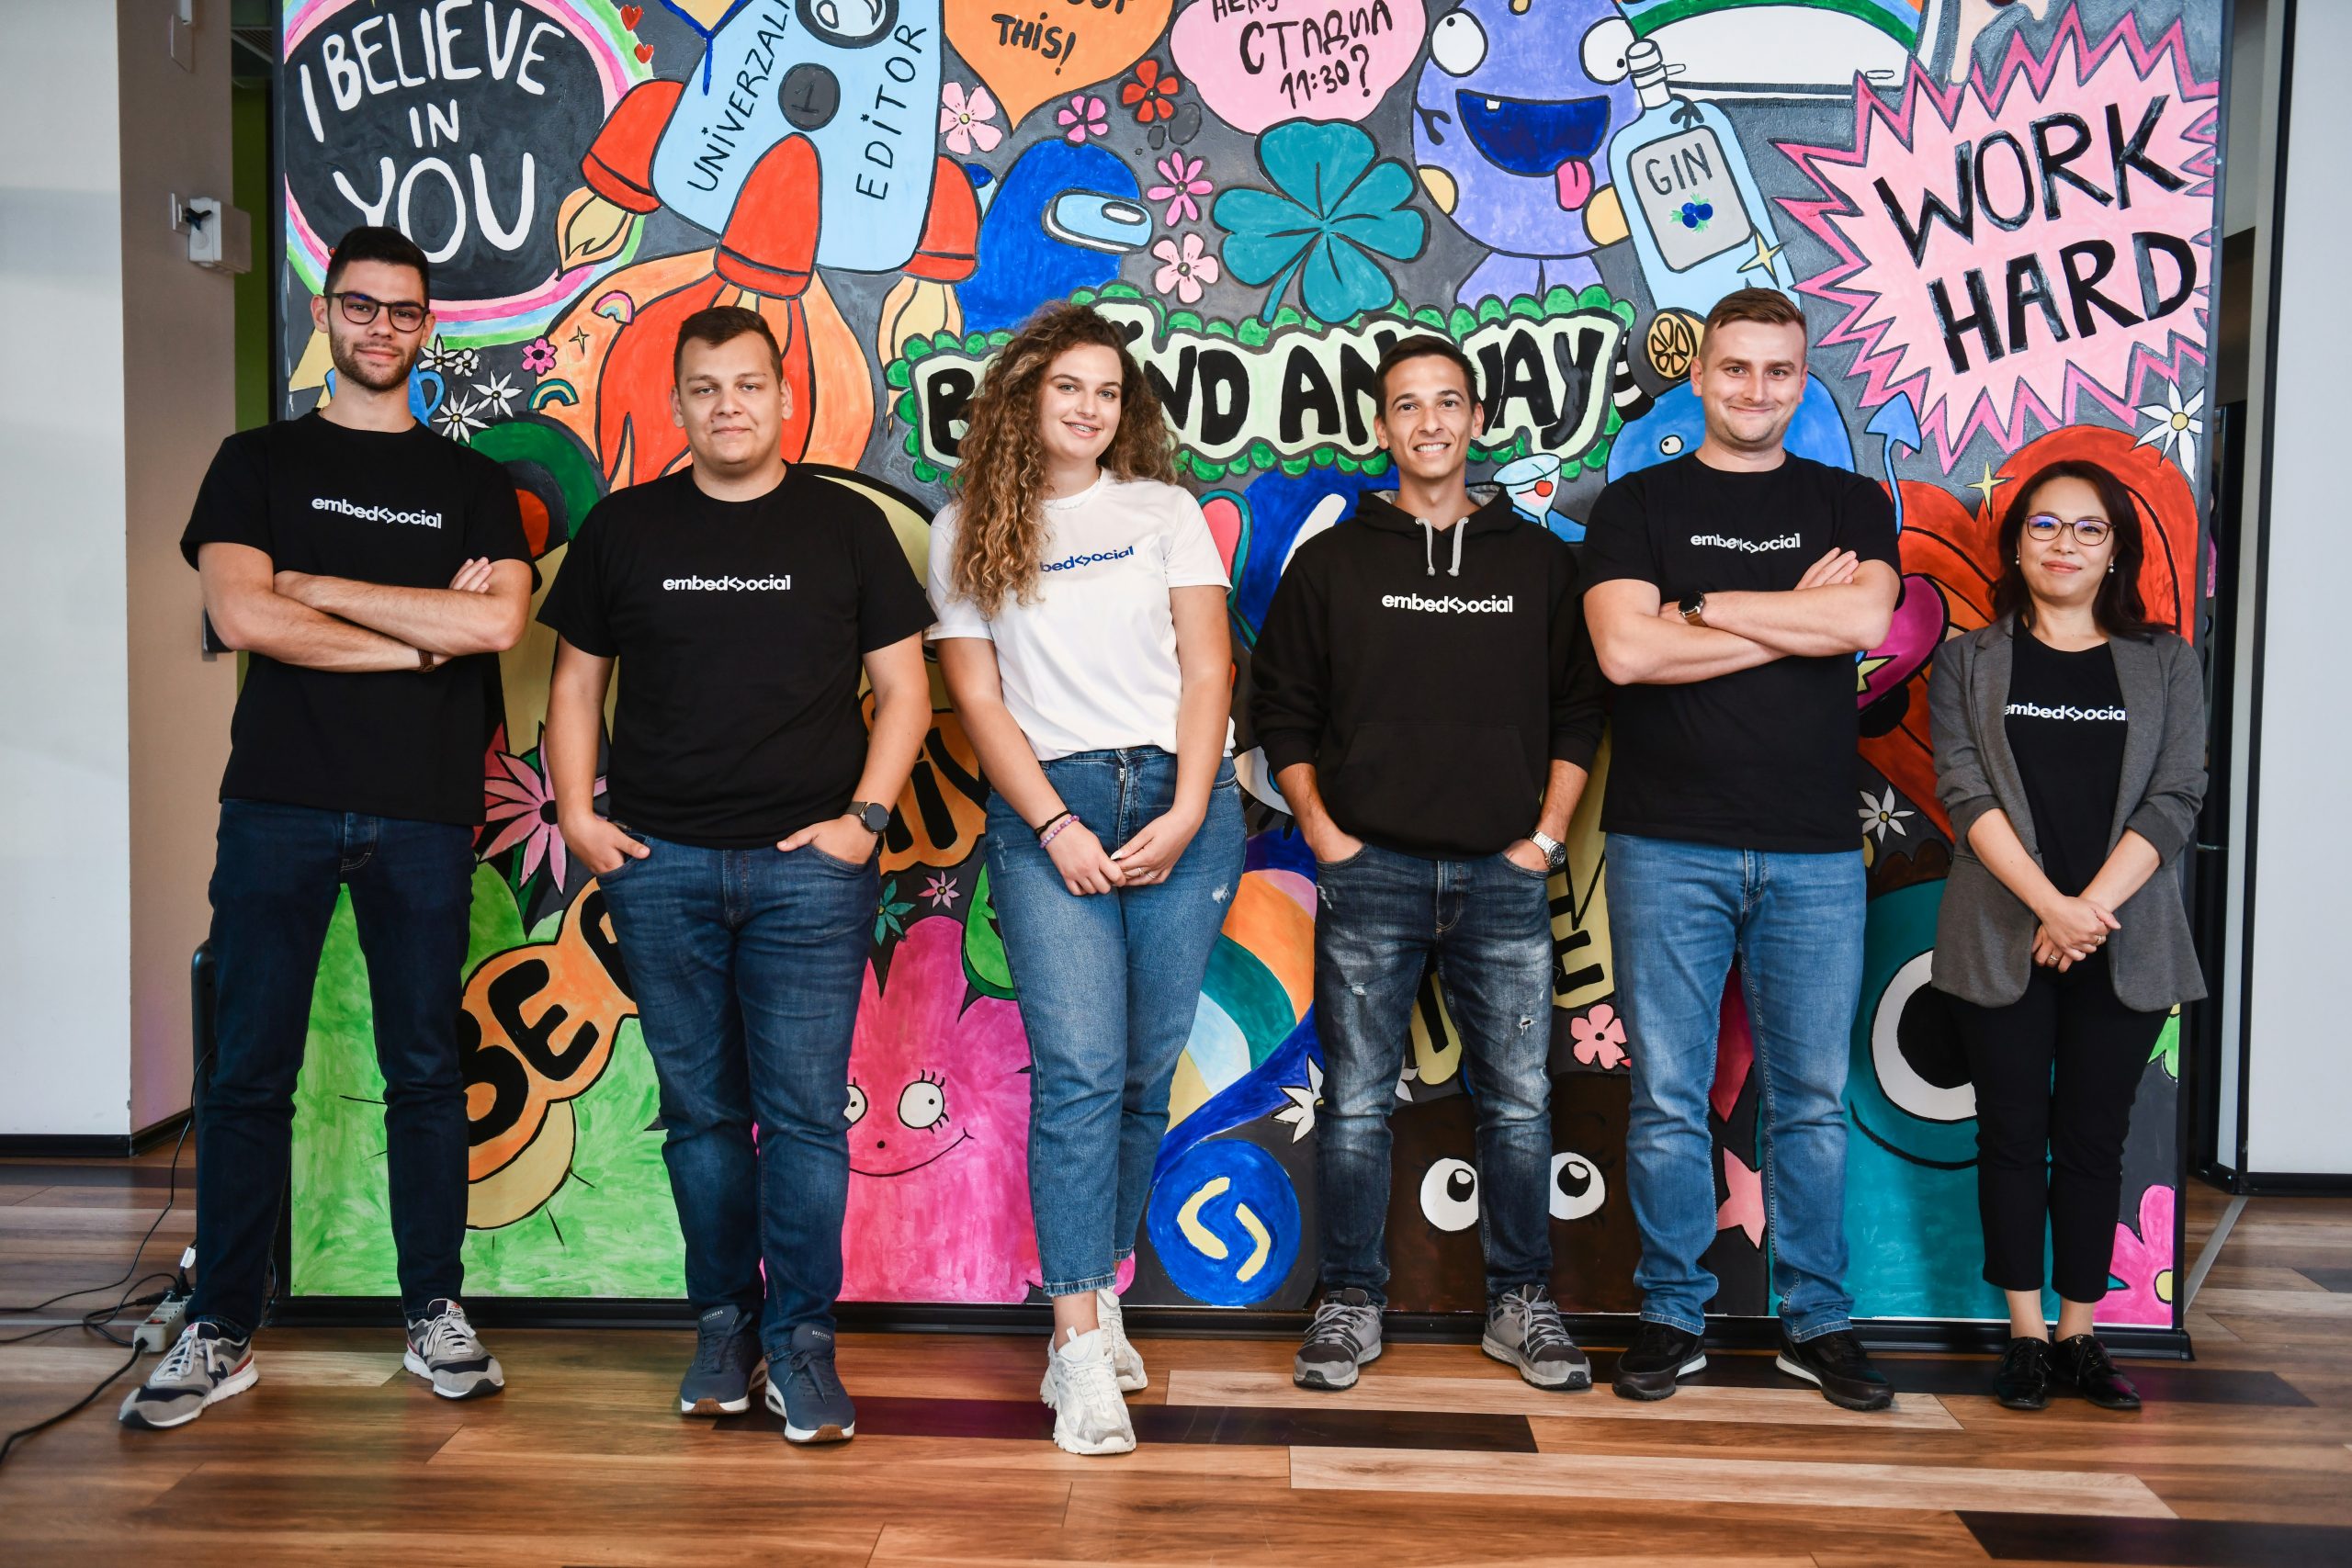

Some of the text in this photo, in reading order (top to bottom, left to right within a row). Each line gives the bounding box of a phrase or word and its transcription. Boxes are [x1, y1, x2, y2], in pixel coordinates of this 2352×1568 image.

[300, 0, 566, 142] I BELIEVE
[686, 0, 790, 191] UNIVERZAL
[991, 12, 1076, 75] THIS!
[1280, 44, 1371, 109] 11:30?
[409, 98, 459, 148] IN
[855, 24, 927, 200] EDITOR
[1645, 143, 1713, 196] GIN
[332, 152, 536, 264] YOU
[1872, 94, 2192, 270] WORK
[1926, 231, 2198, 375] HARD
